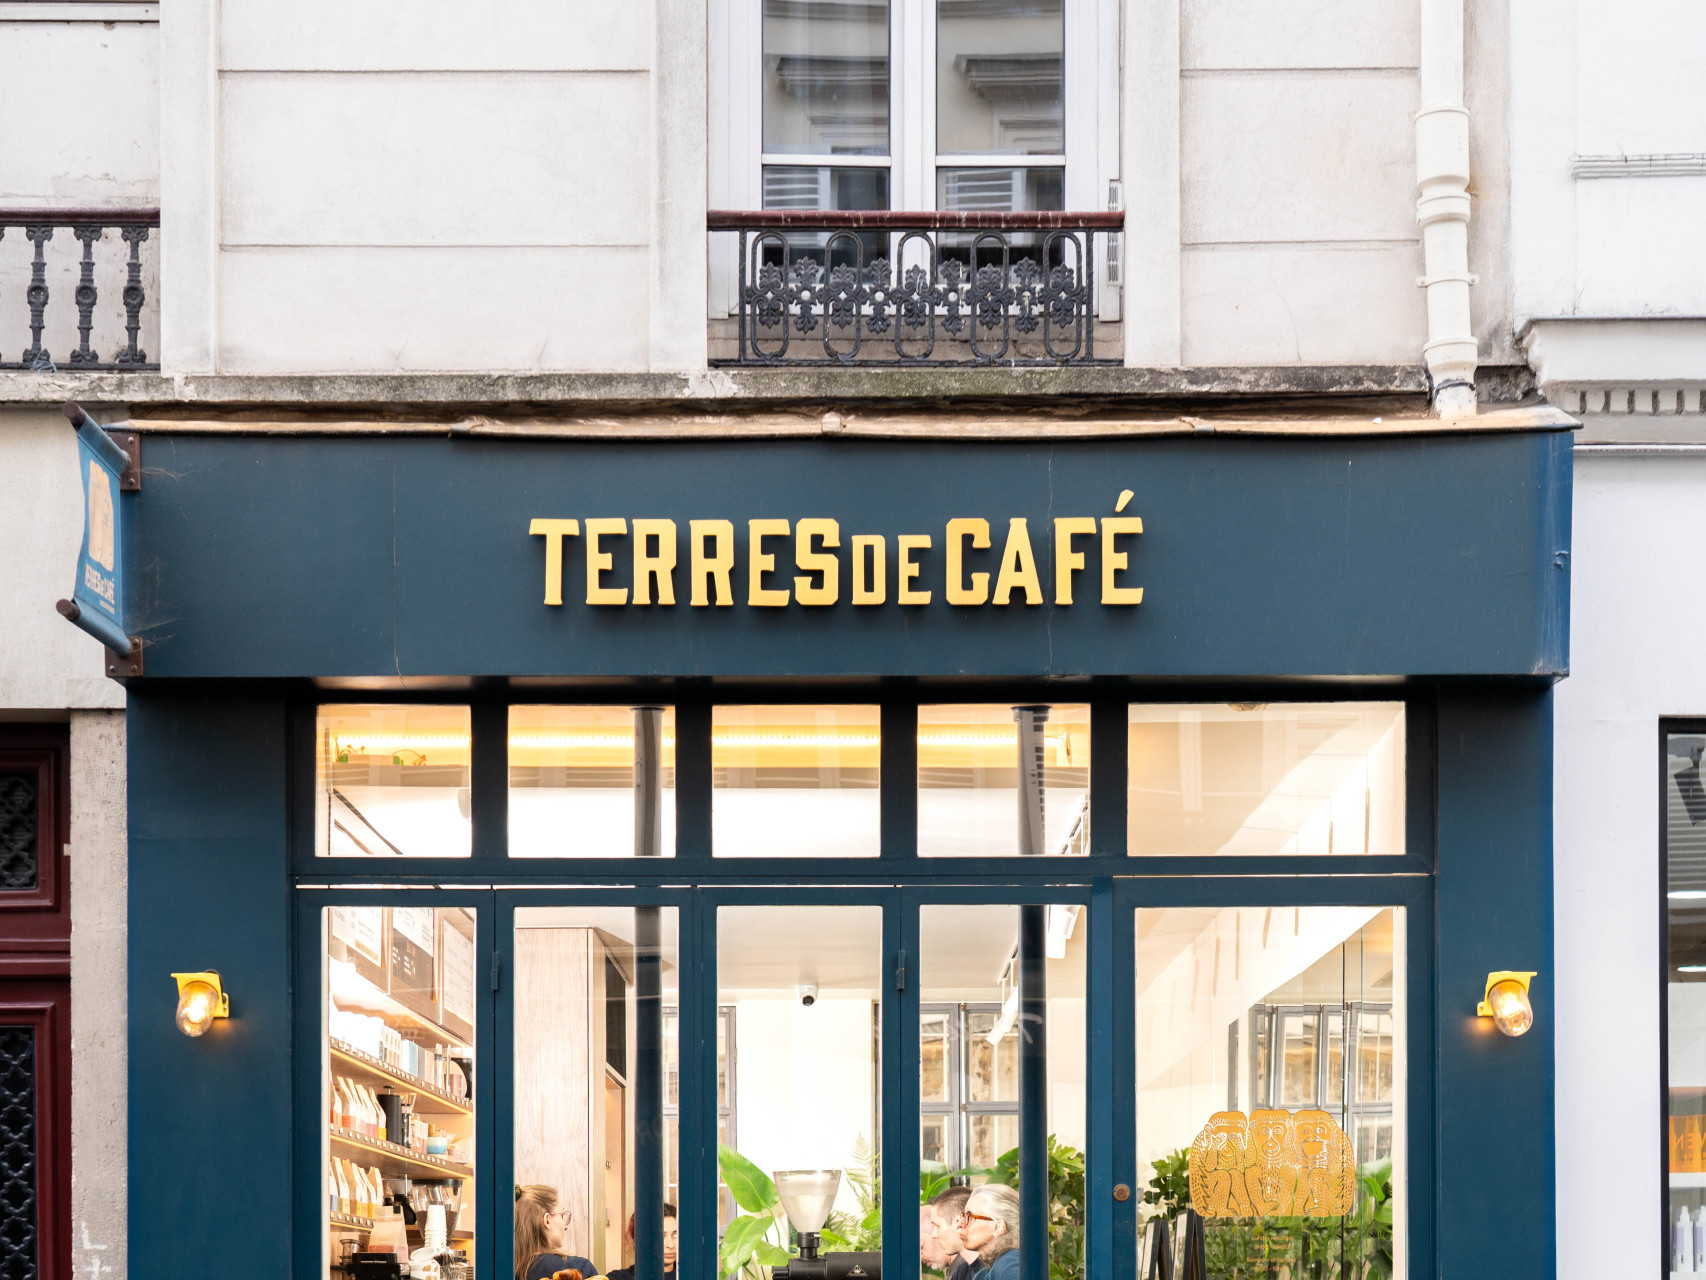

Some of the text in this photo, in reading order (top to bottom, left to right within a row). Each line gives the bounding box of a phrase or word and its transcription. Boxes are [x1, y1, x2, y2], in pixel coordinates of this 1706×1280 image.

[528, 488, 1144, 607] TERRES DE CAFÉ
